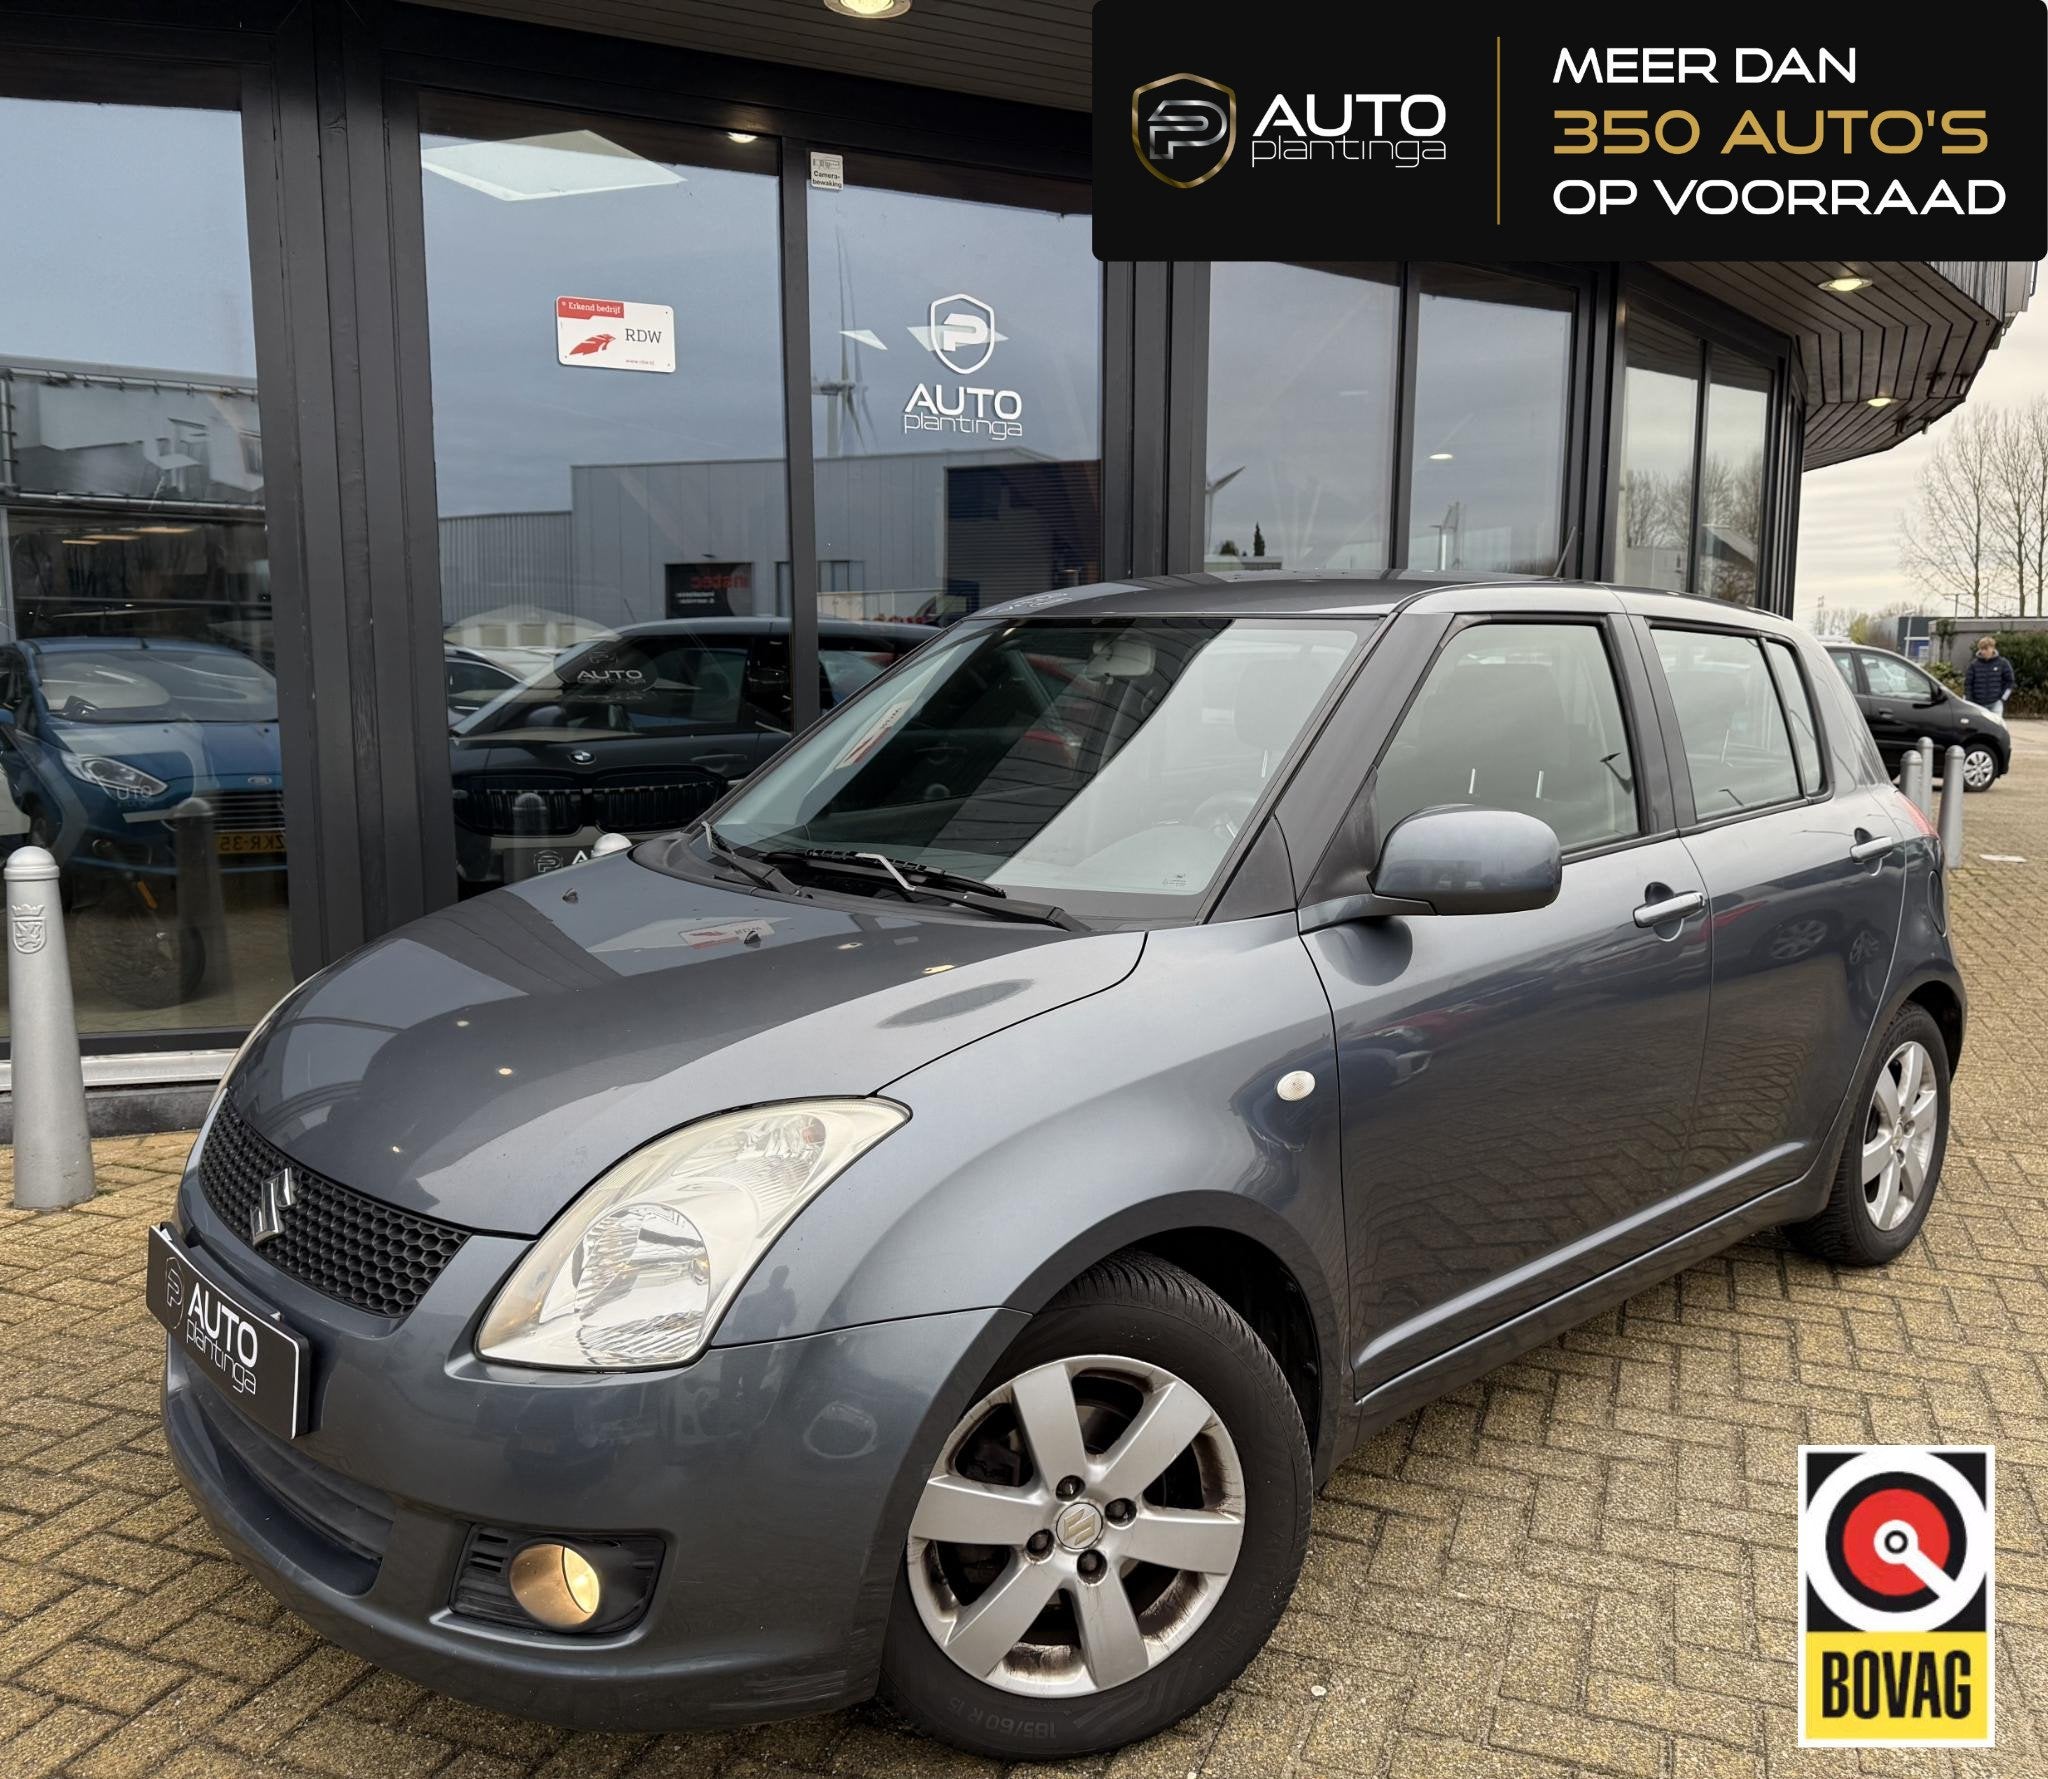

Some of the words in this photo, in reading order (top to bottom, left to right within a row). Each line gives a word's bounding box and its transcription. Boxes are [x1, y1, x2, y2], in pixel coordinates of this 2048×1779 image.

[568, 301, 595, 311] Erkend
[596, 304, 621, 315] bedrijf
[624, 328, 662, 344] RDW
[904, 383, 1022, 420] AUTO
[904, 412, 1023, 441] plantinga
[577, 669, 643, 680] AUTO
[188, 1282, 258, 1368] AUTO
[186, 1319, 256, 1395] plantinga
